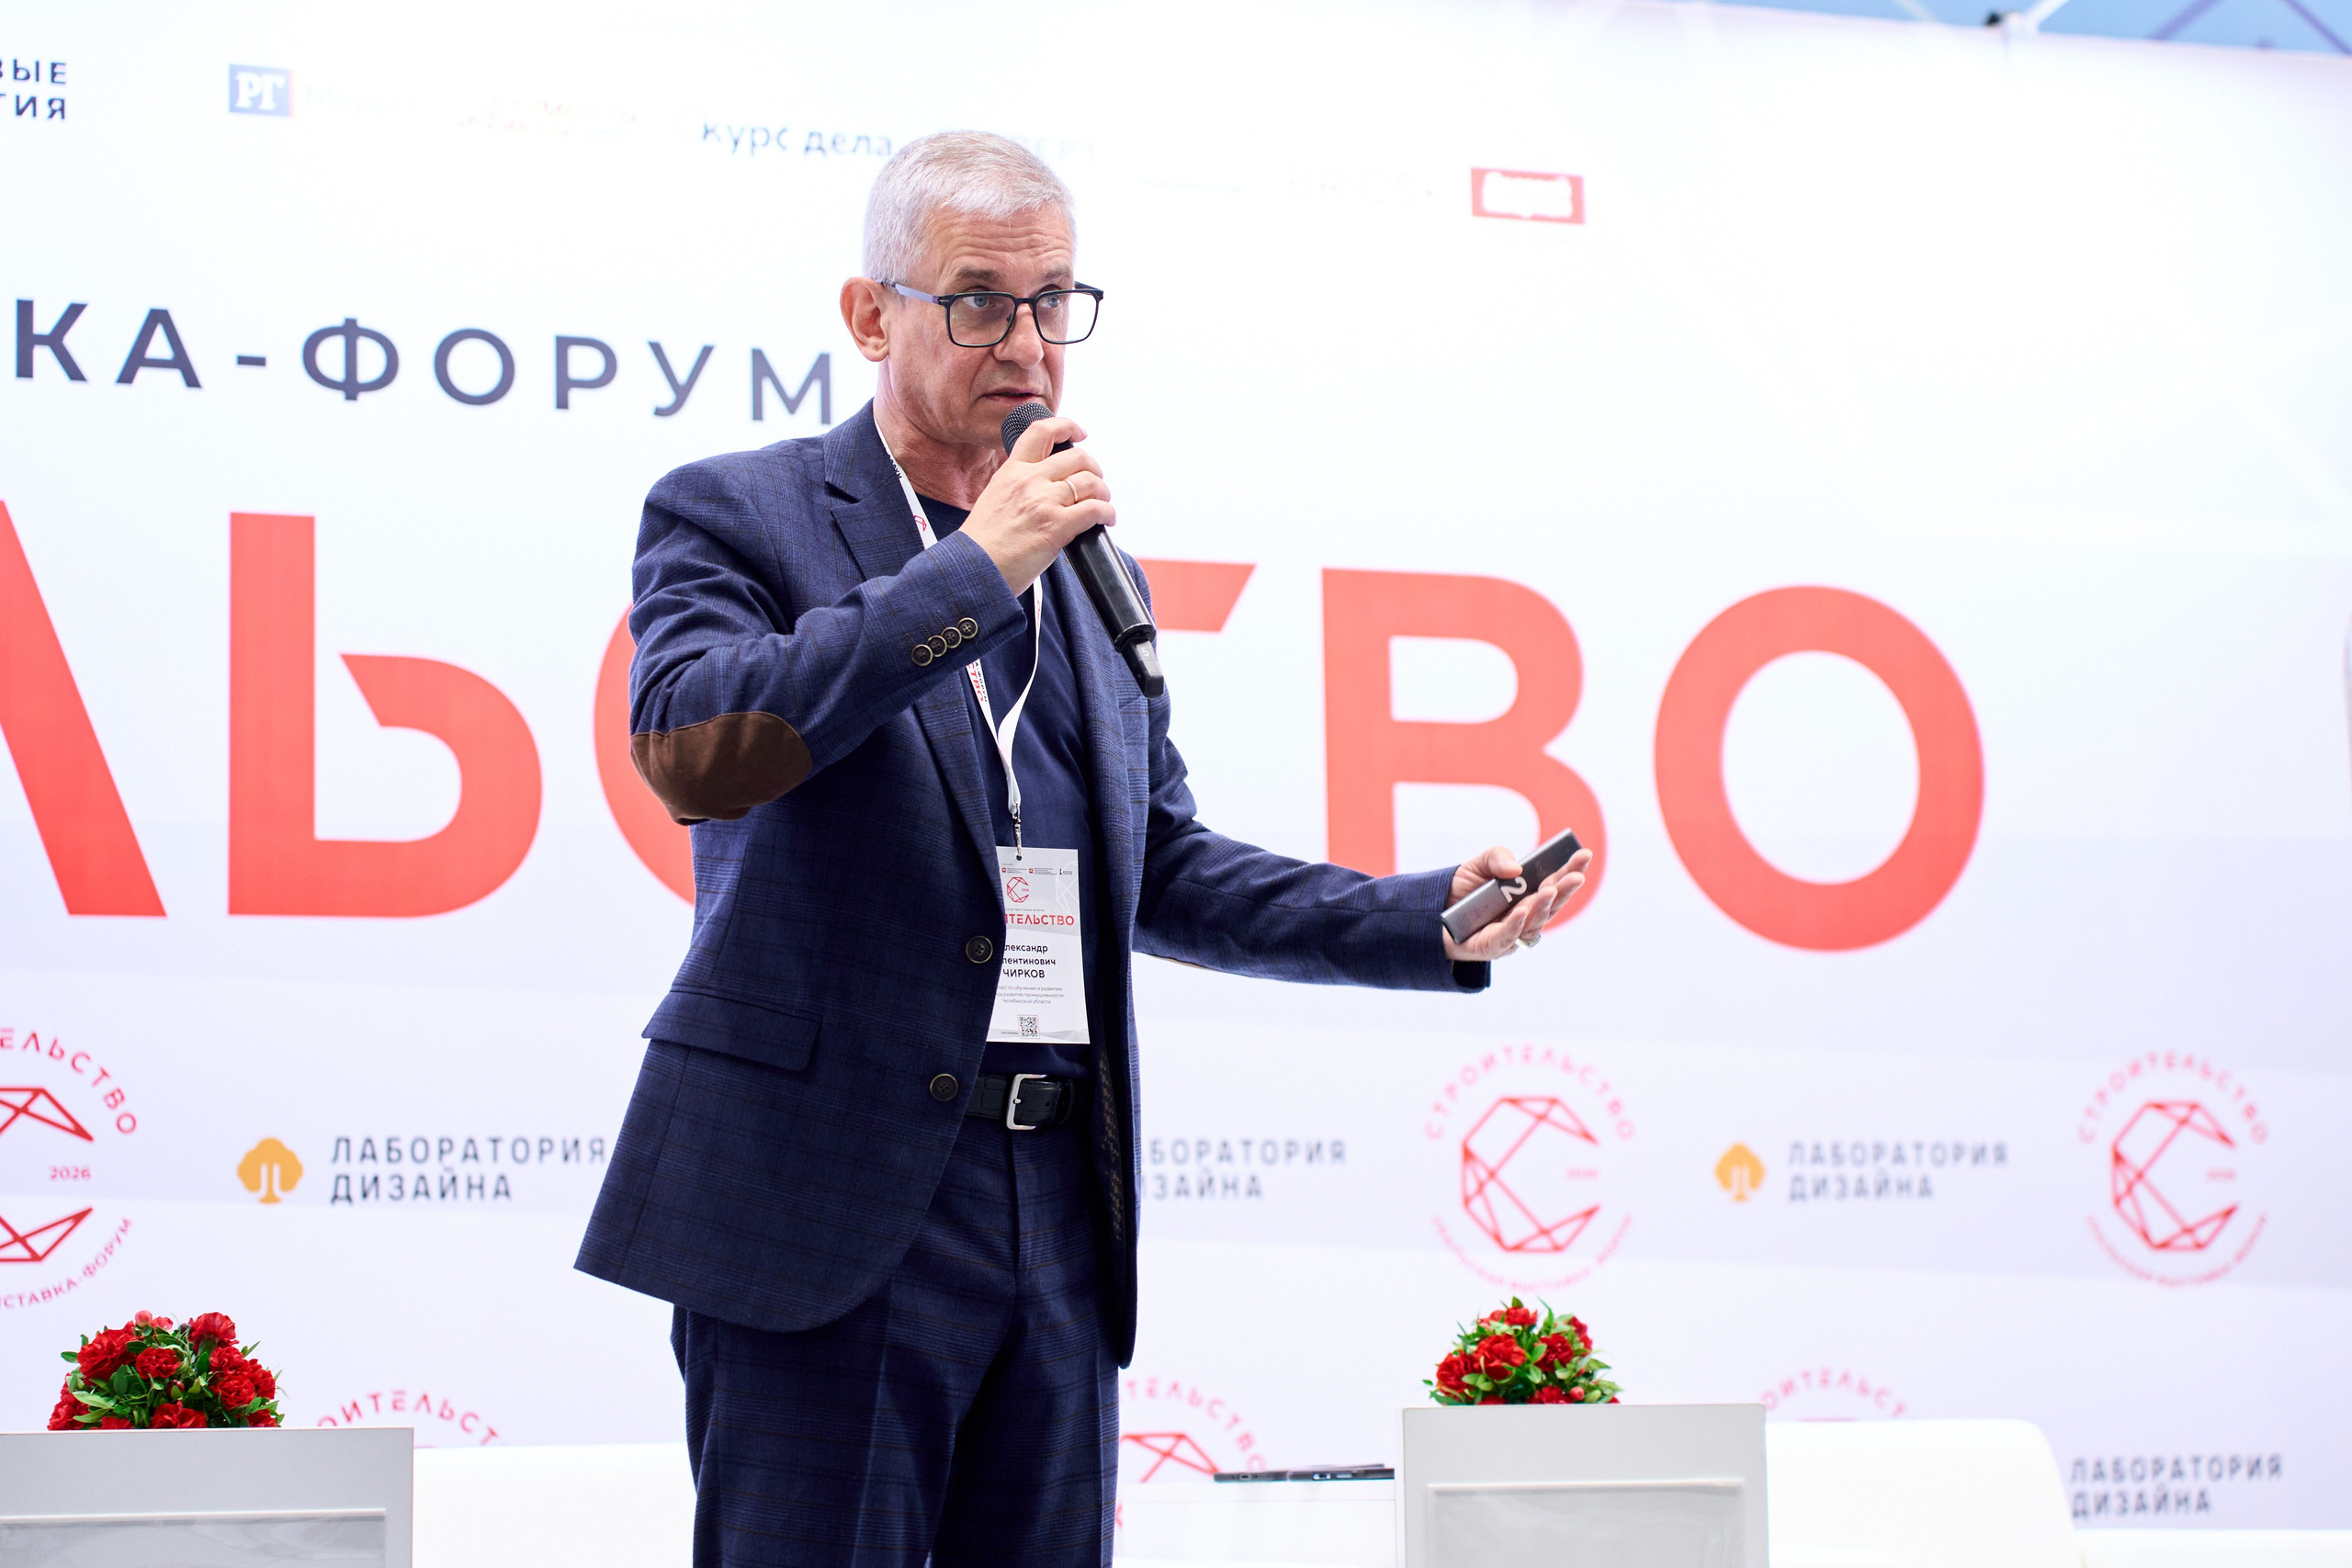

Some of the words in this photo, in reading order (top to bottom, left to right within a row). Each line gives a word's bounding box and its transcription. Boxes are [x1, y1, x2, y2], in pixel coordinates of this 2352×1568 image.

[0, 58, 66, 85] ЫЕ
[235, 71, 286, 110] РГ
[703, 121, 787, 156] курс
[804, 130, 893, 157] дела
[15, 296, 832, 426] КА-ФОРУМ
[1141, 647, 1150, 657] 5
[1500, 875, 1528, 904] 2
[1002, 957, 1057, 966] лентинович
[1004, 944, 1048, 954] лександр
[1002, 968, 1046, 979] ЧИРКОВ
[331, 1136, 606, 1165] ЛАБОРАТОРИЯ
[1148, 1137, 1347, 1167] БОРАТОРИЯ
[1788, 1140, 2009, 1168] ЛАБОРАТОРИЯ
[50, 1167, 91, 1181] 2026
[330, 1166, 512, 1205] ДИЗАЙНА
[1142, 1168, 1262, 1201] ЗАЙНА
[1788, 1167, 1934, 1203] ДИЗАЙНА
[0, 1218, 131, 1309] СТАВКА-ФОРУМ
[2070, 1453, 2285, 1483] ЛАБОРАТОРИЯ
[2070, 1483, 2212, 1521] ДИЗАЙНА
